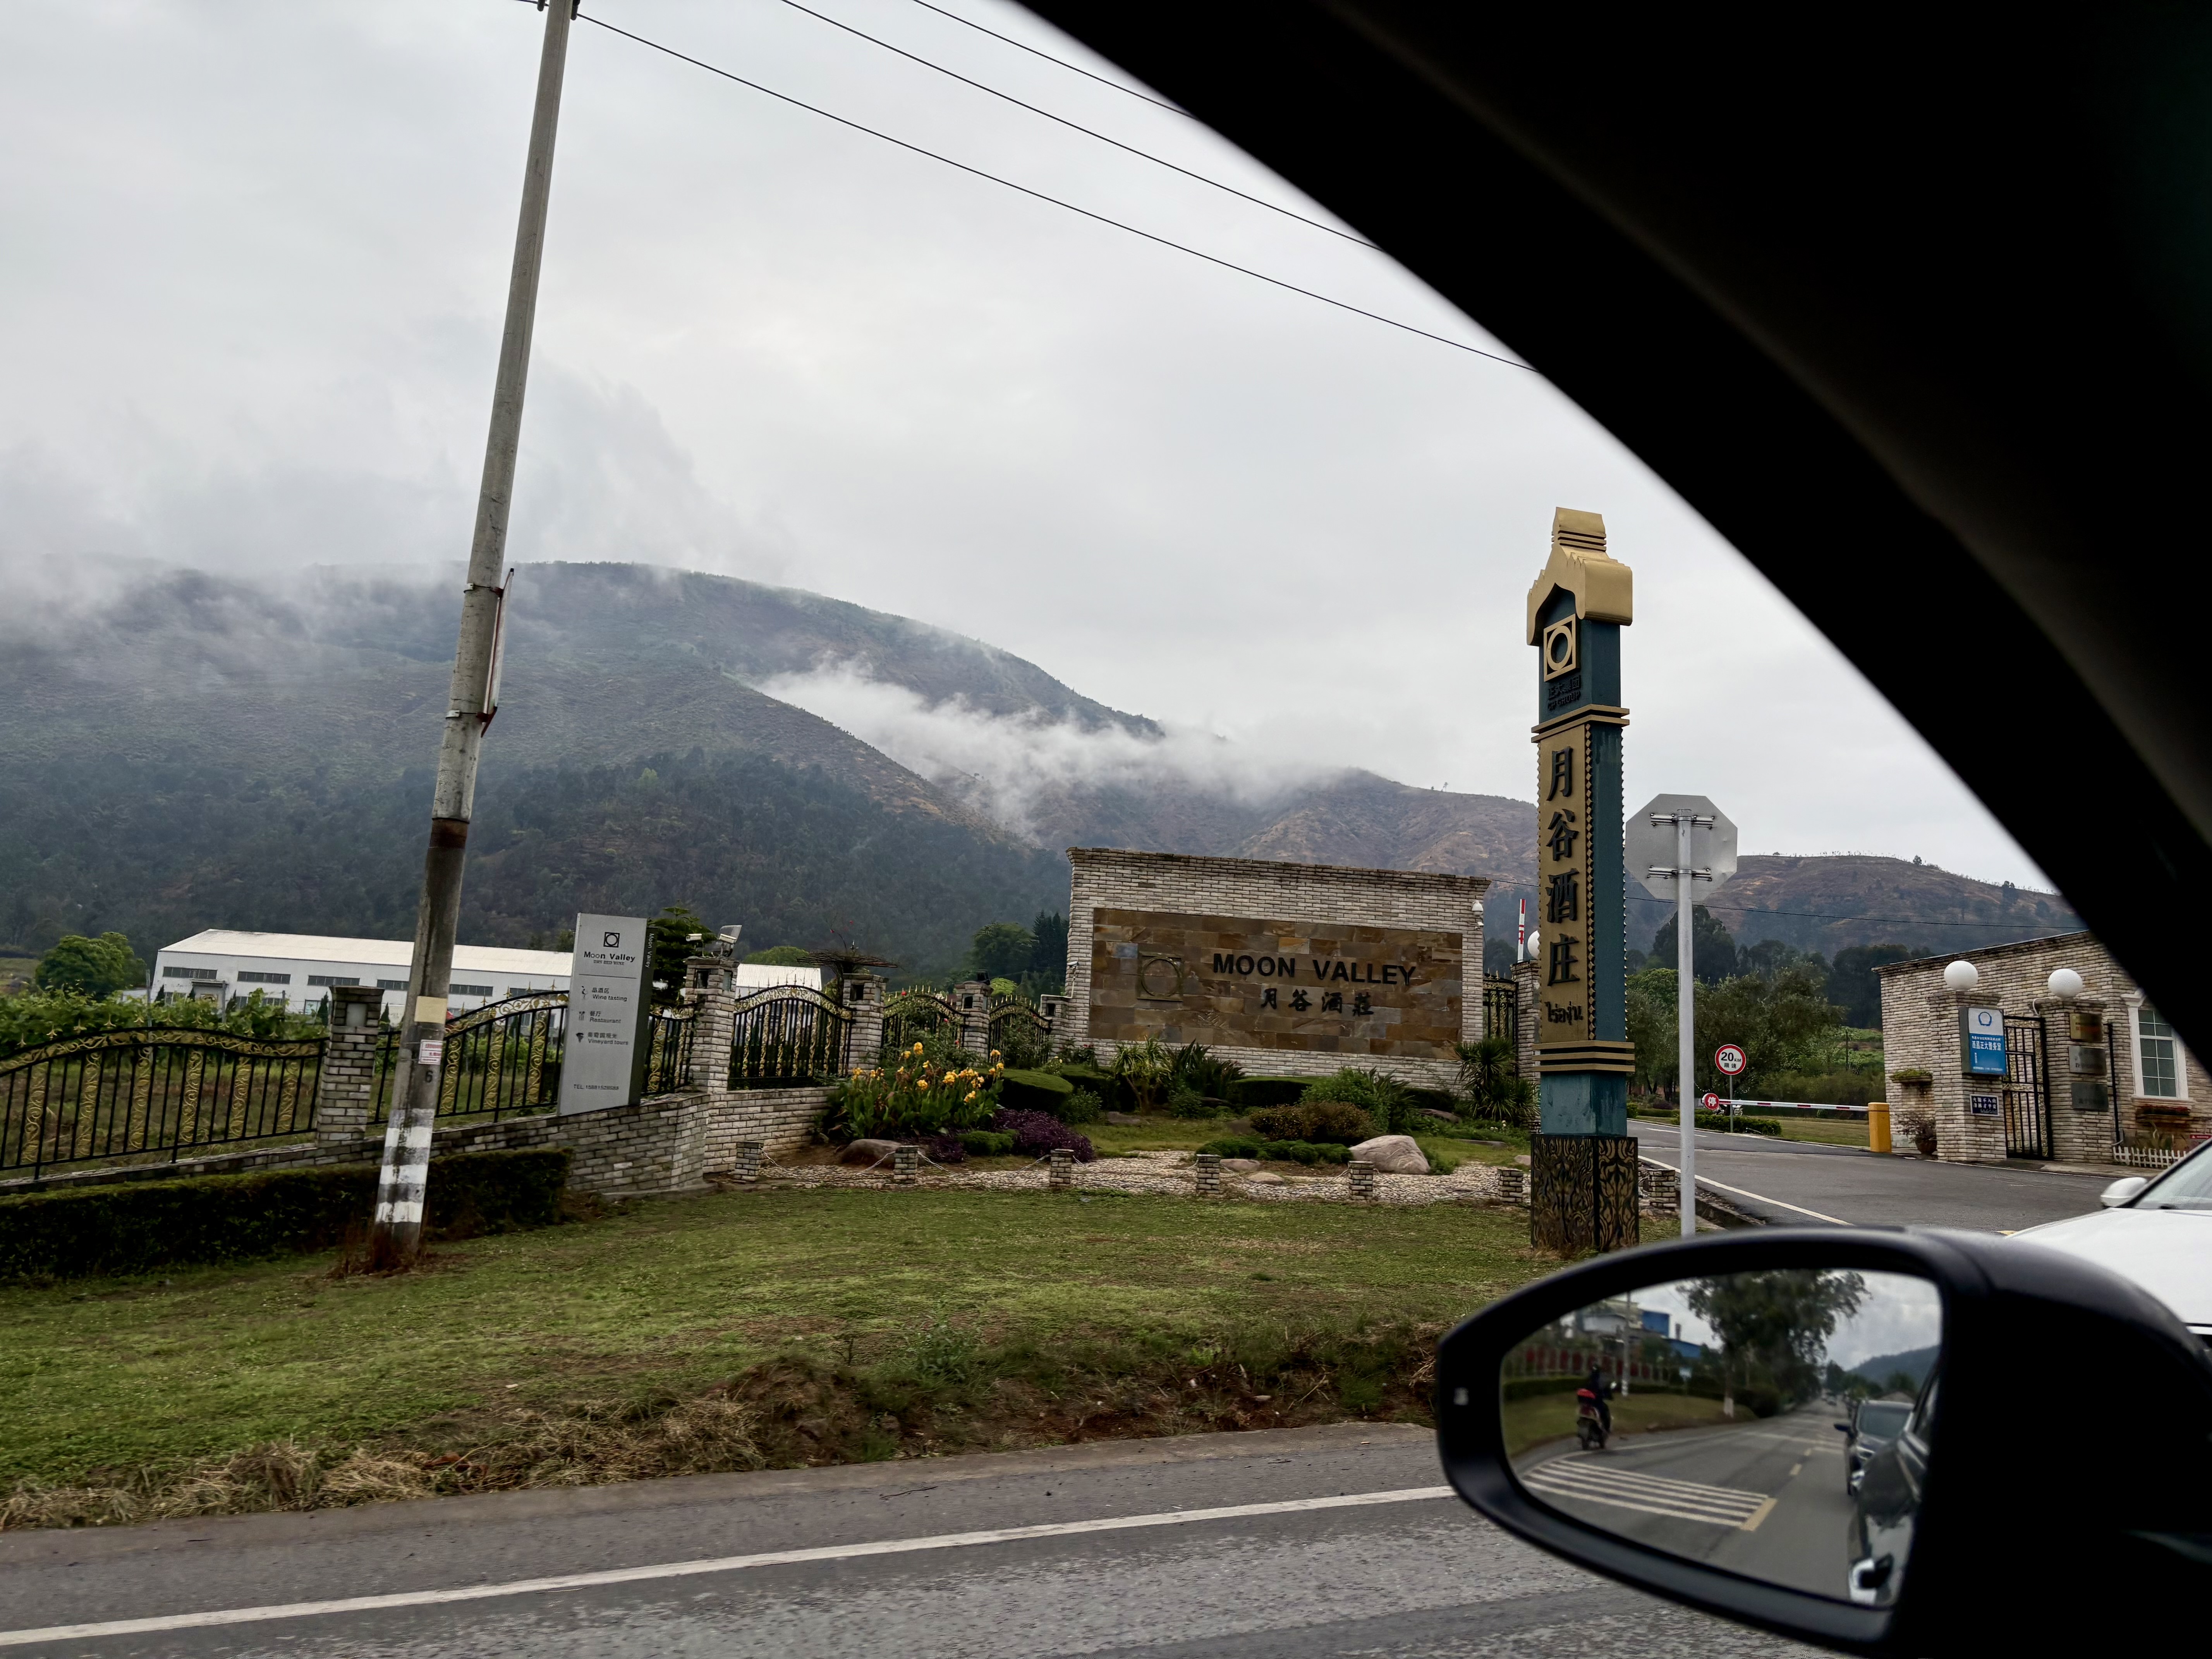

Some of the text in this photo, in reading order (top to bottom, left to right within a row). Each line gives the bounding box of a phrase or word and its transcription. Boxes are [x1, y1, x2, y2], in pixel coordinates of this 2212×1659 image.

[1557, 690, 1581, 706] GROUP
[1547, 745, 1579, 987] 月谷酒庄
[610, 953, 635, 962] Valley
[1213, 953, 1416, 985] MOON VALLEY
[1721, 1052, 1734, 1061] 20
[426, 1070, 433, 1083] 6
